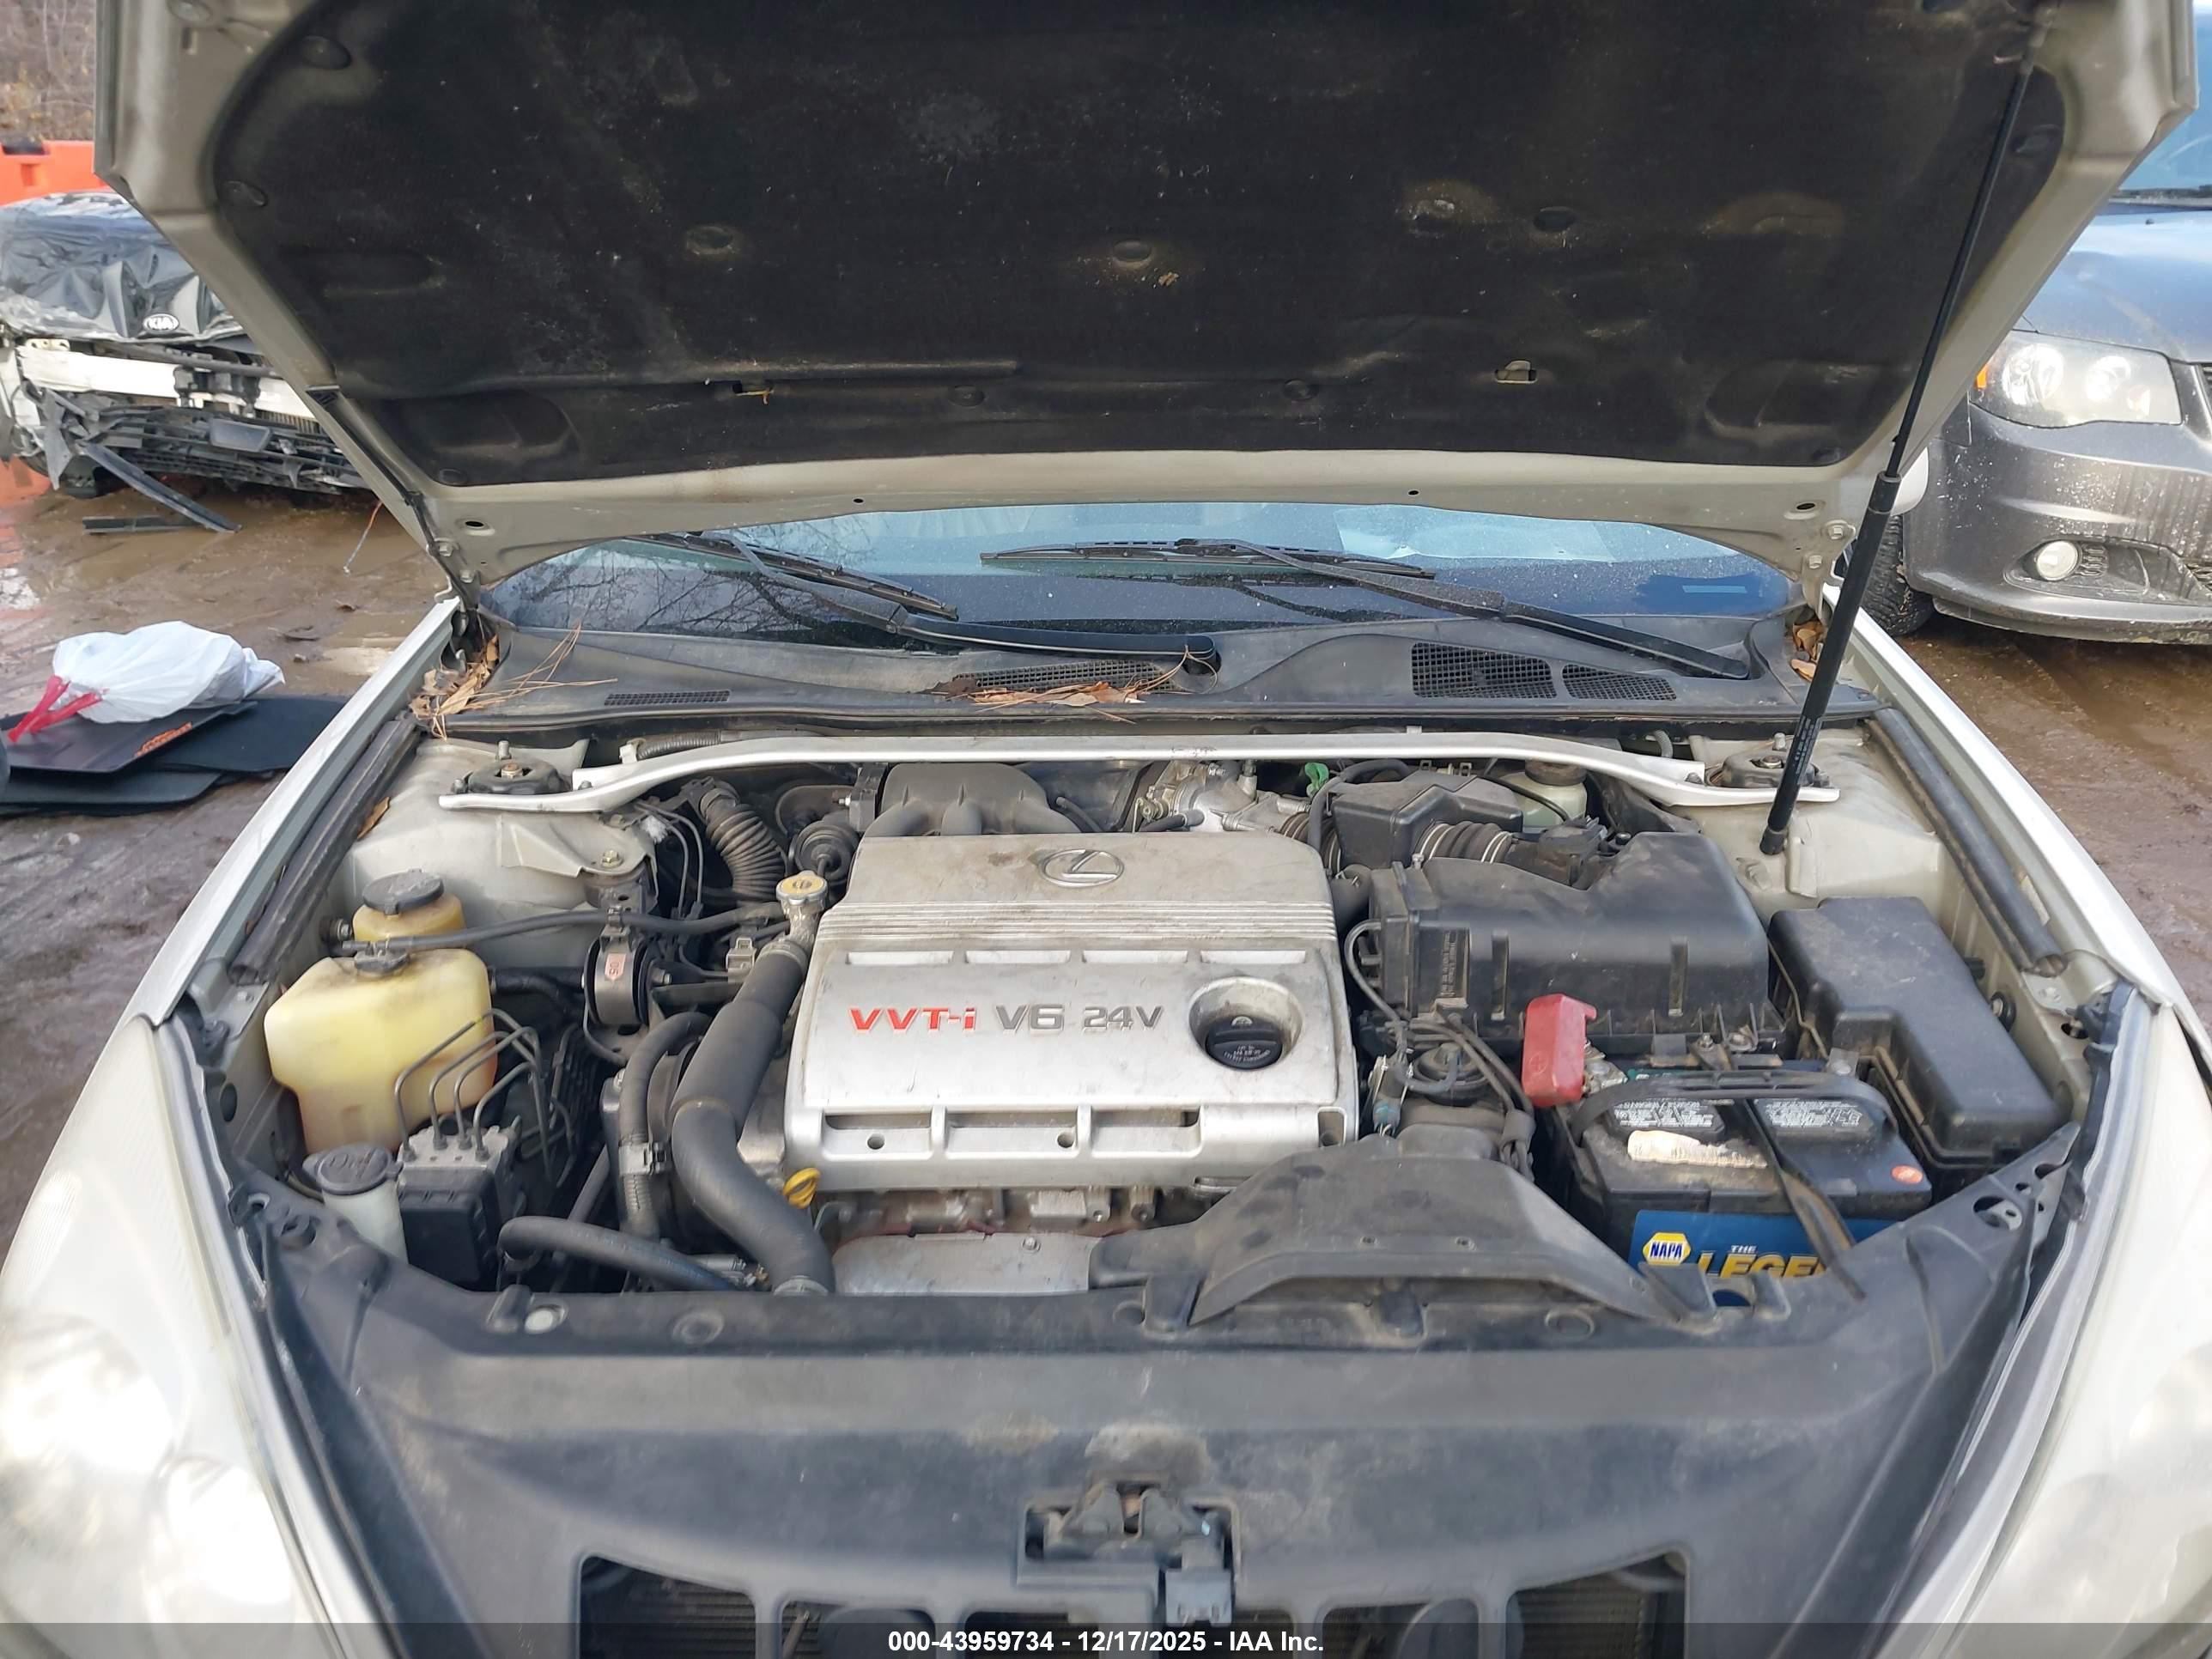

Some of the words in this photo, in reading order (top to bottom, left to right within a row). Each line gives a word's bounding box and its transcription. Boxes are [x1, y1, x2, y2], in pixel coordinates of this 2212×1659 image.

[849, 1007, 977, 1033] VVT-i
[995, 1004, 1065, 1032] V6
[1084, 1006, 1163, 1031] 24V
[1650, 1242, 1684, 1259] NAPA
[1730, 1245, 1758, 1255] THE
[1698, 1251, 1827, 1279] LEGE
